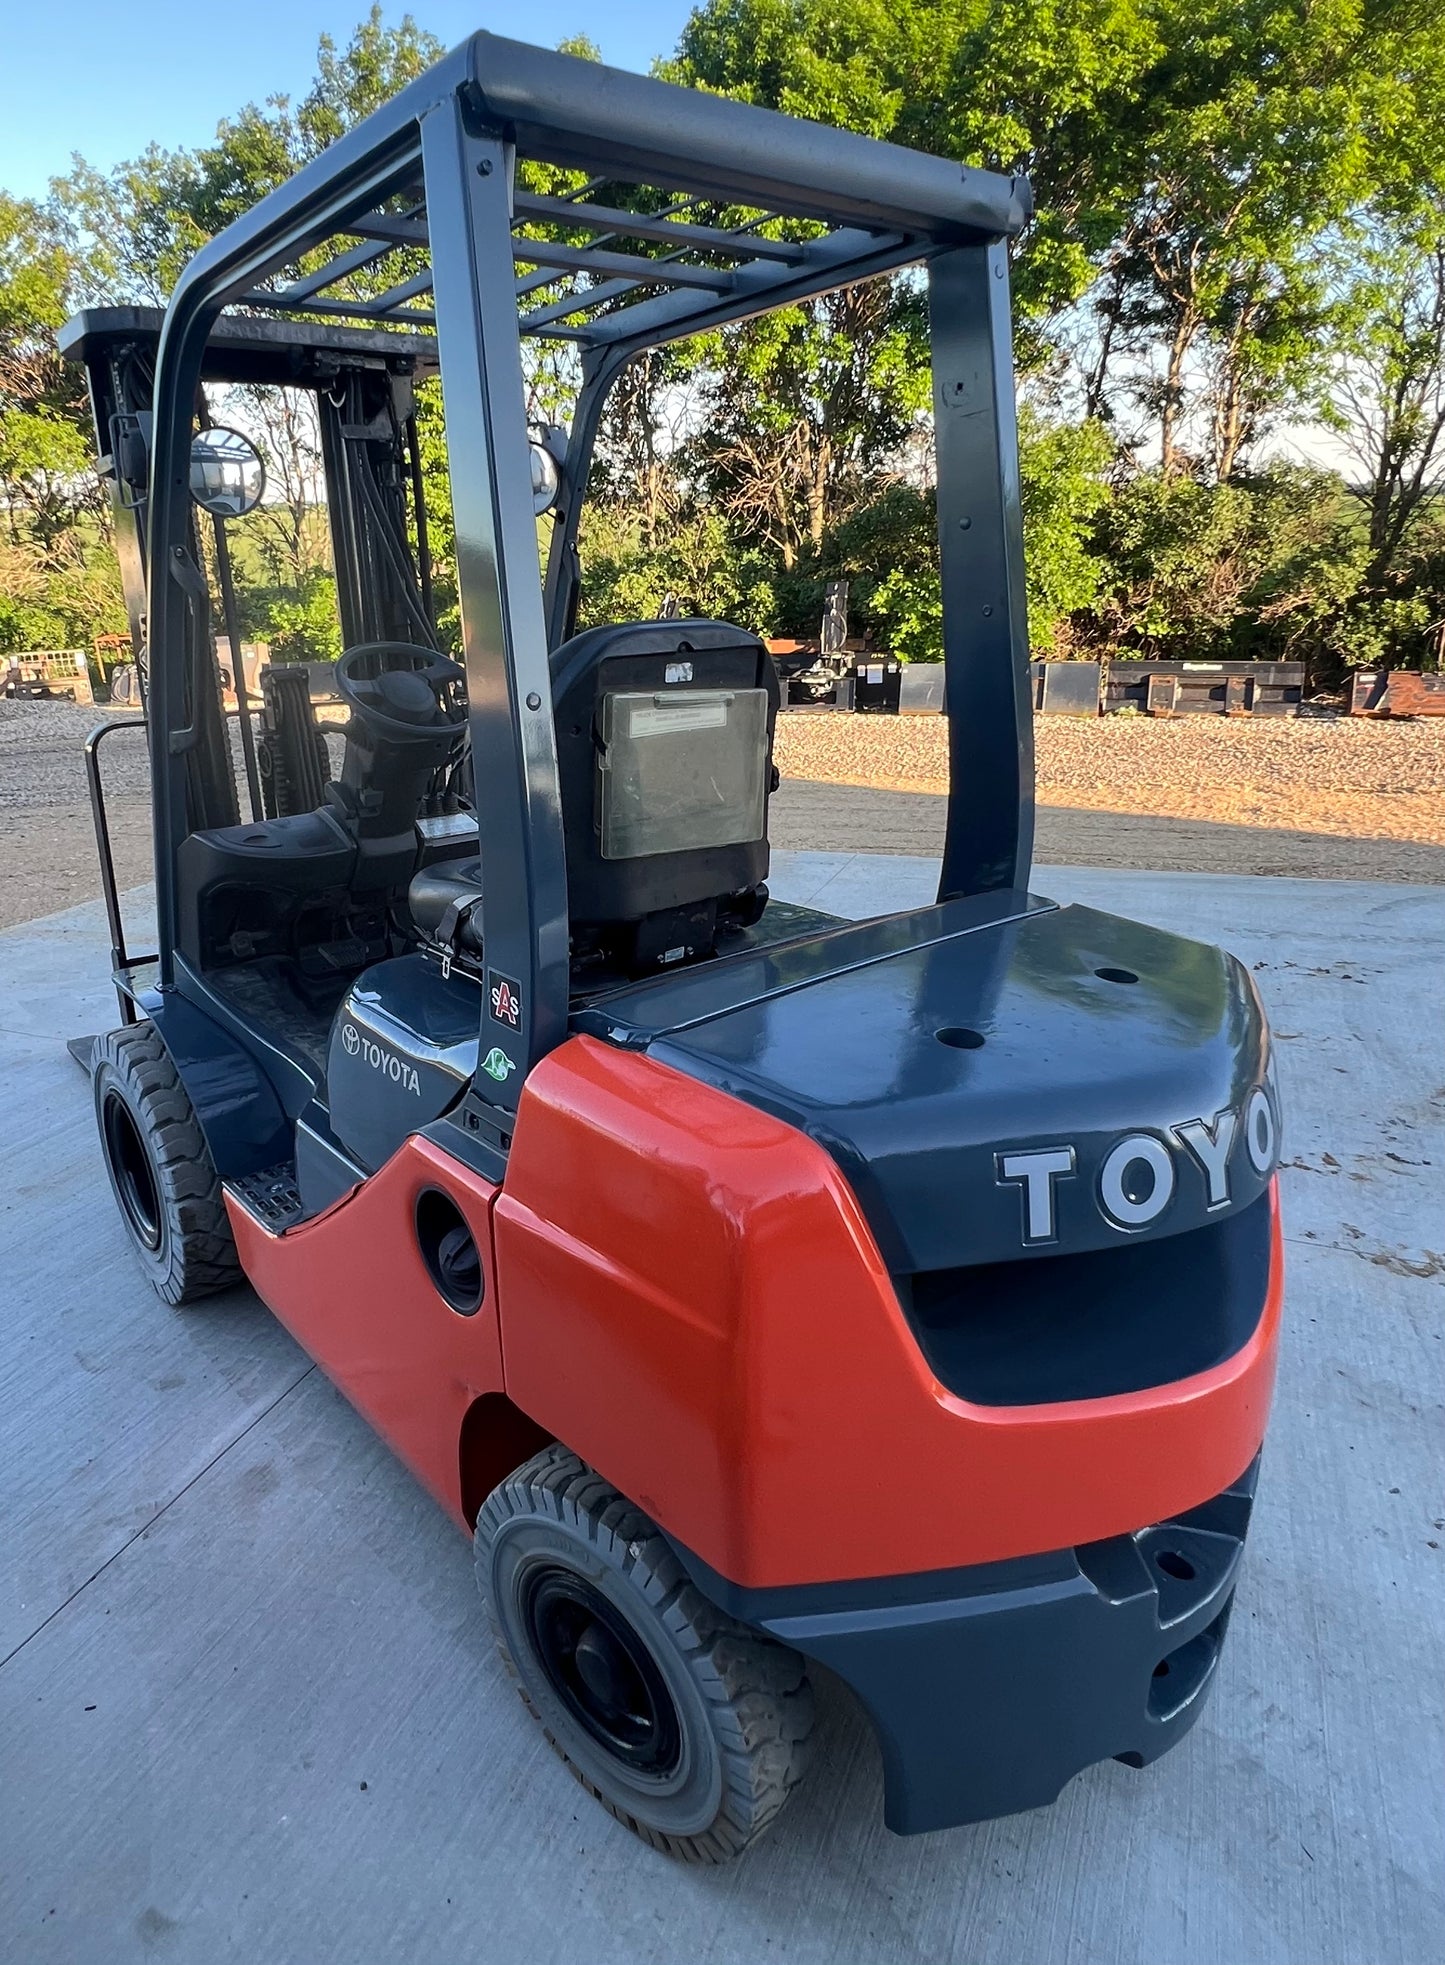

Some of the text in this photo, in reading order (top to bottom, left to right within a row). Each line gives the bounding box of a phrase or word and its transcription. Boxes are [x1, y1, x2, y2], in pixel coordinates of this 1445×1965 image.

[491, 981, 519, 1025] SAS
[362, 1037, 421, 1097] TOYOTA
[999, 1089, 1275, 1241] TOYO
